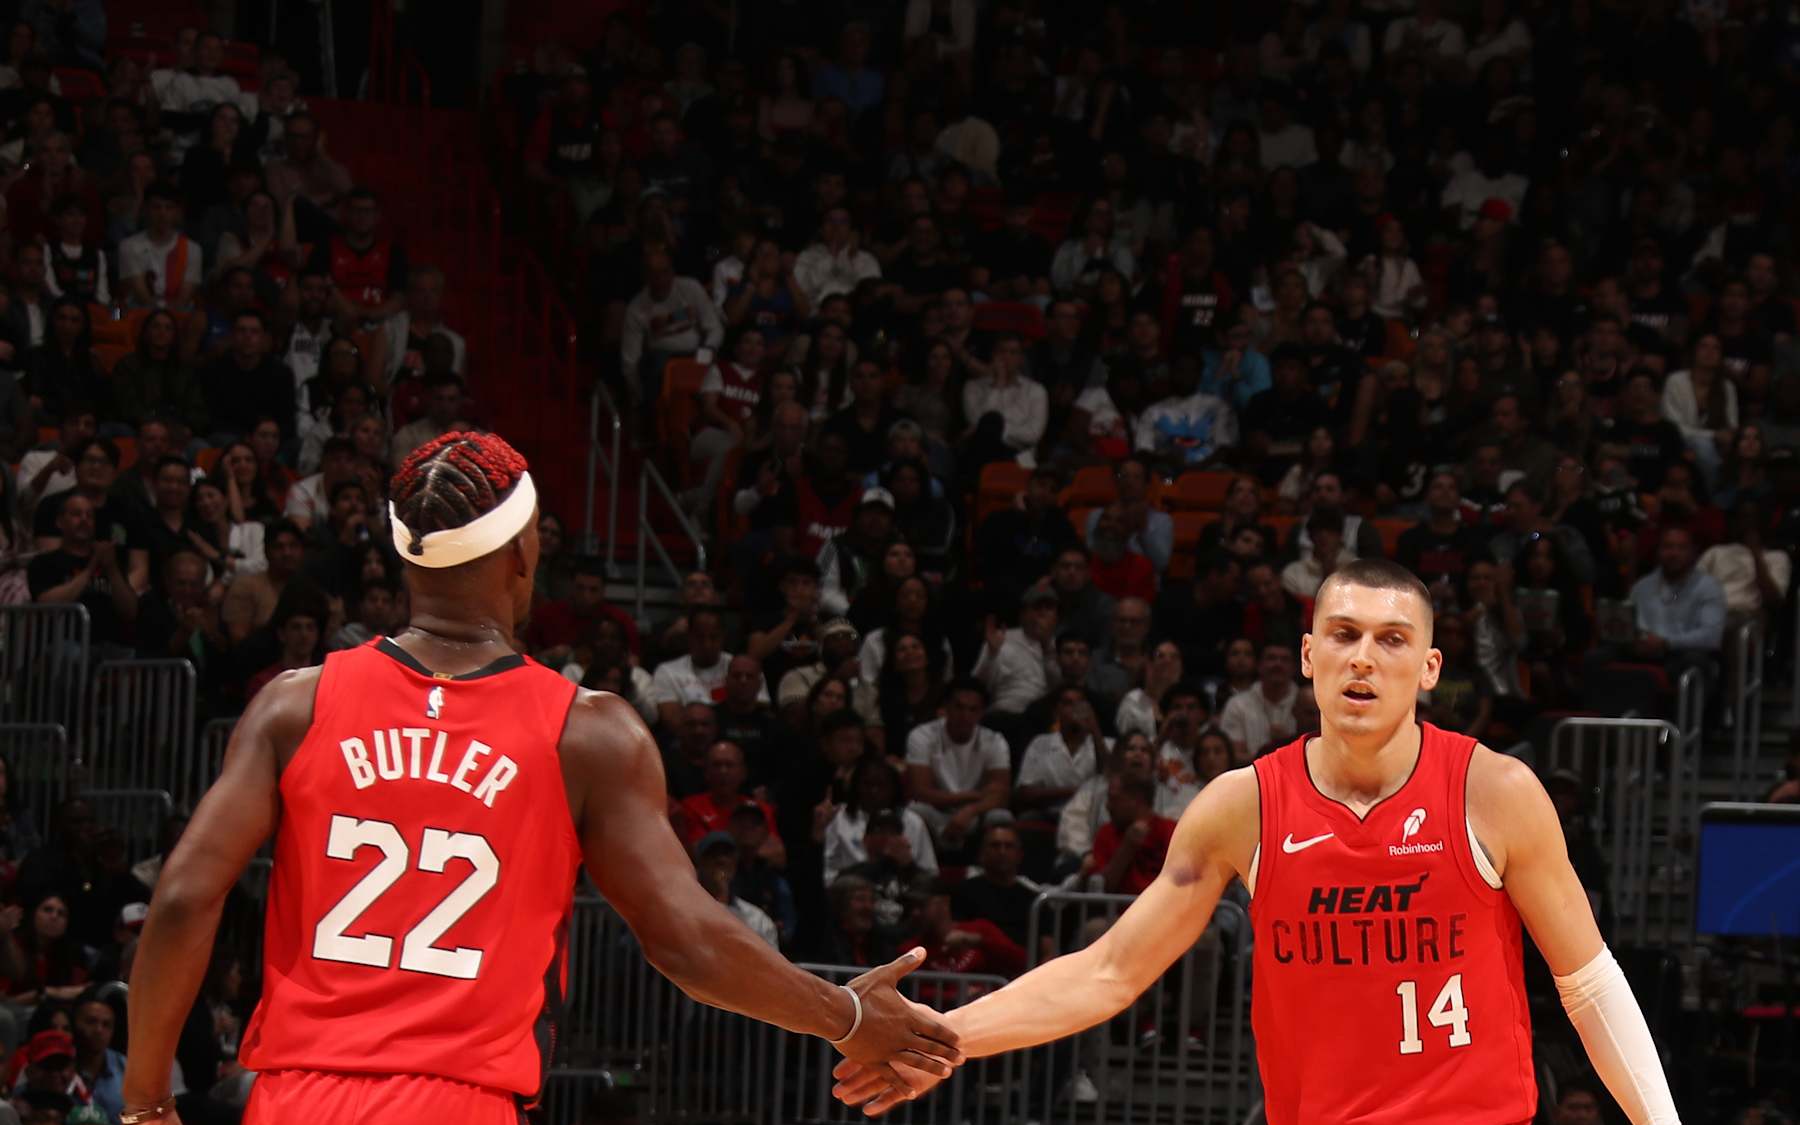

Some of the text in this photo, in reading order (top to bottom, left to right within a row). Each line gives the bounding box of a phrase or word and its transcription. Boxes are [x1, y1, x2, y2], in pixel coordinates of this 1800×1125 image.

[340, 728, 518, 808] BUTLER
[1389, 841, 1443, 856] Robinhood
[312, 814, 501, 979] 22
[1309, 873, 1429, 913] HEAT
[1273, 914, 1467, 965] CULTURE
[1396, 973, 1472, 1055] 14
